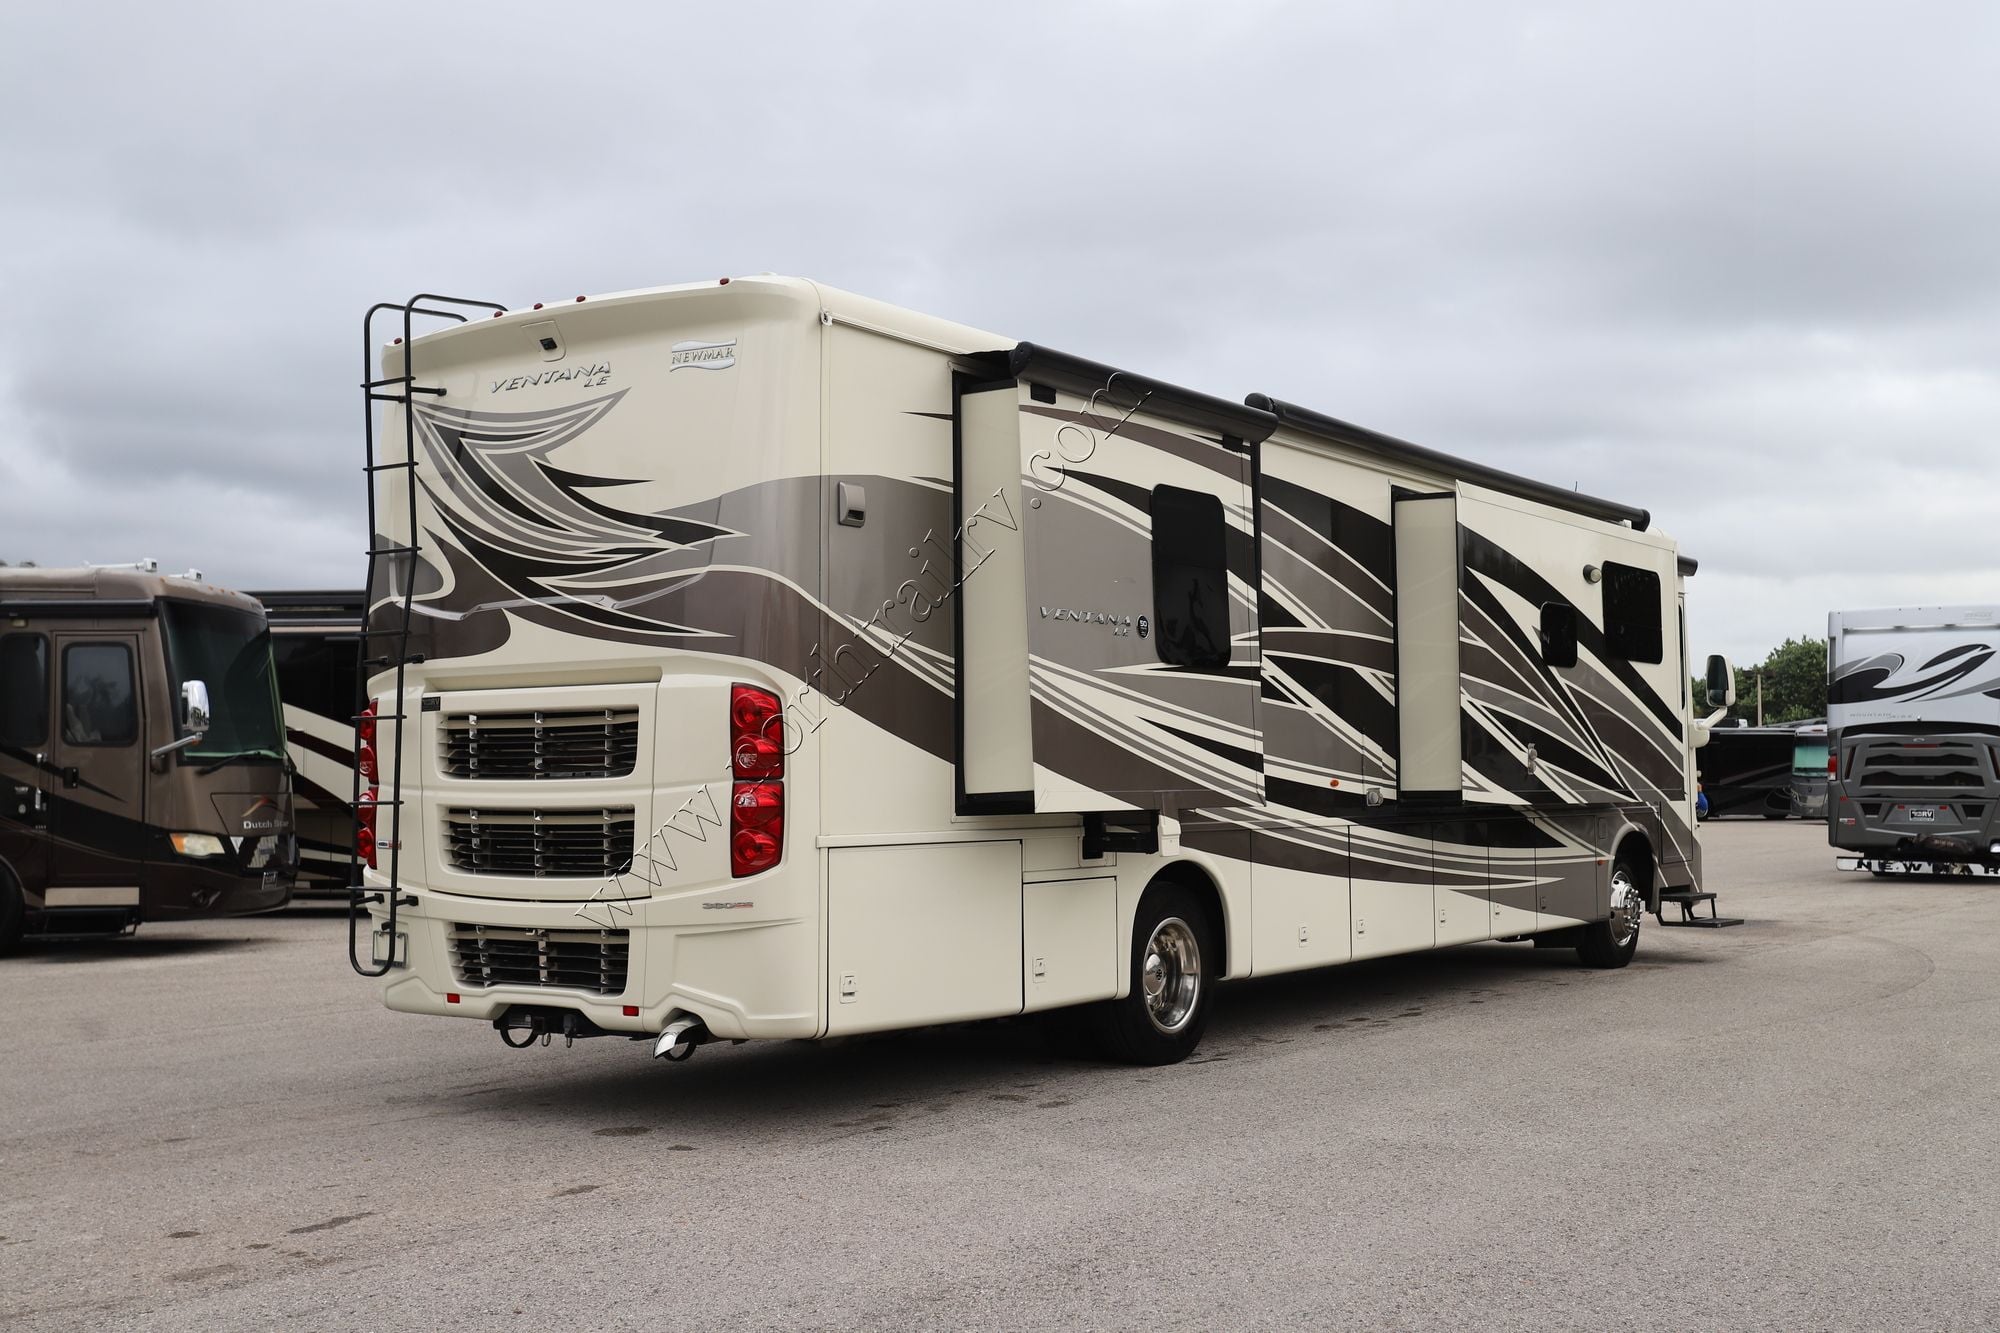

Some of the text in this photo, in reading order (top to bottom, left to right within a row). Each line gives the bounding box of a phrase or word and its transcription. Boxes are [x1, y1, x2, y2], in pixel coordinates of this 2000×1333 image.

[671, 347, 735, 365] NEWMAR
[490, 361, 611, 394] VENTANA
[583, 375, 611, 388] LE
[1040, 606, 1131, 627] VENTANA
[1113, 627, 1131, 637] LE
[243, 820, 273, 830] Dutch
